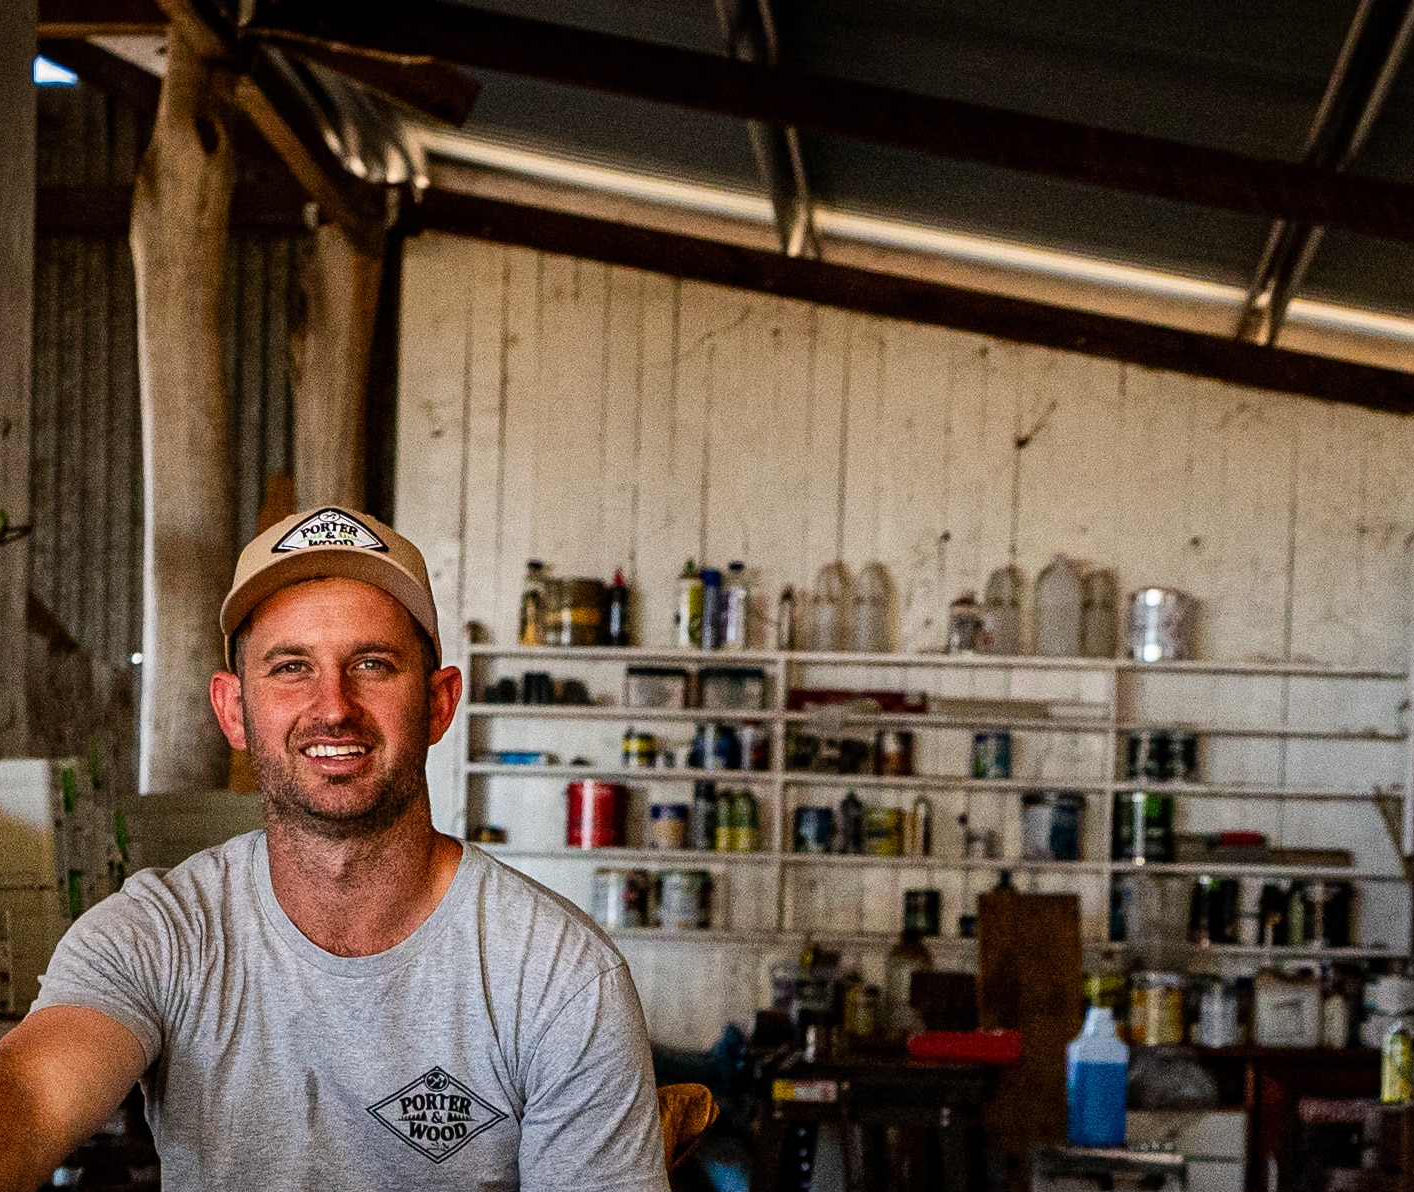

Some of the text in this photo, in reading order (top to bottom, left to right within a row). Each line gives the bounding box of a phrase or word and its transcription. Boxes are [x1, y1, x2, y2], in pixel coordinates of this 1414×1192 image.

[300, 521, 358, 538] PORTER
[325, 532, 336, 540] &
[398, 1093, 472, 1115] PORTER
[431, 1111, 445, 1124] &
[409, 1121, 467, 1141] WOOD
